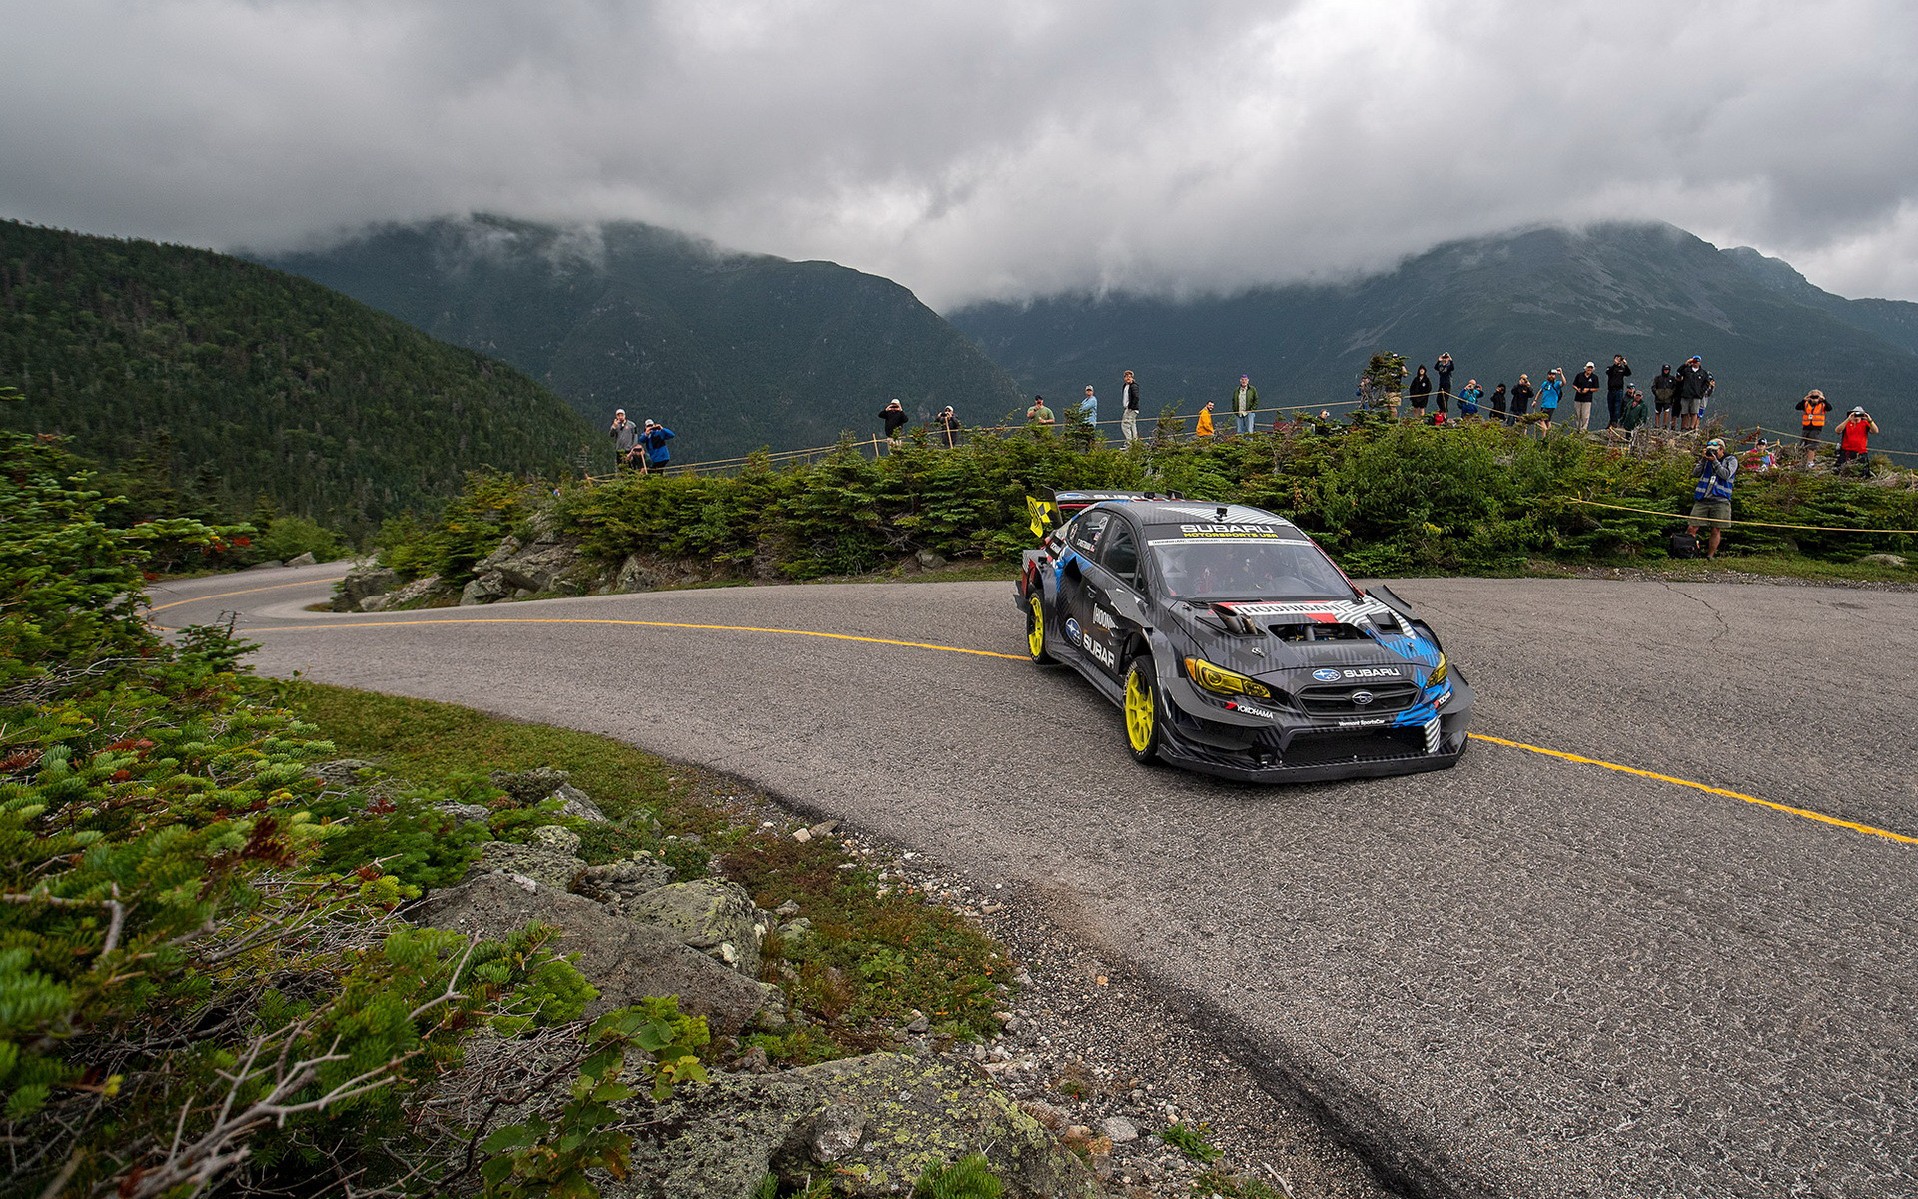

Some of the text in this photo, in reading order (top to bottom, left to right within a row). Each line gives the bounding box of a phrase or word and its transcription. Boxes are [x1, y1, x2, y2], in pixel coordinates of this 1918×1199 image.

[1180, 524, 1275, 534] SUBARU
[1083, 633, 1115, 669] SUBAR
[1343, 667, 1401, 678] SUBARU
[1237, 704, 1274, 719] YOKOHAMA
